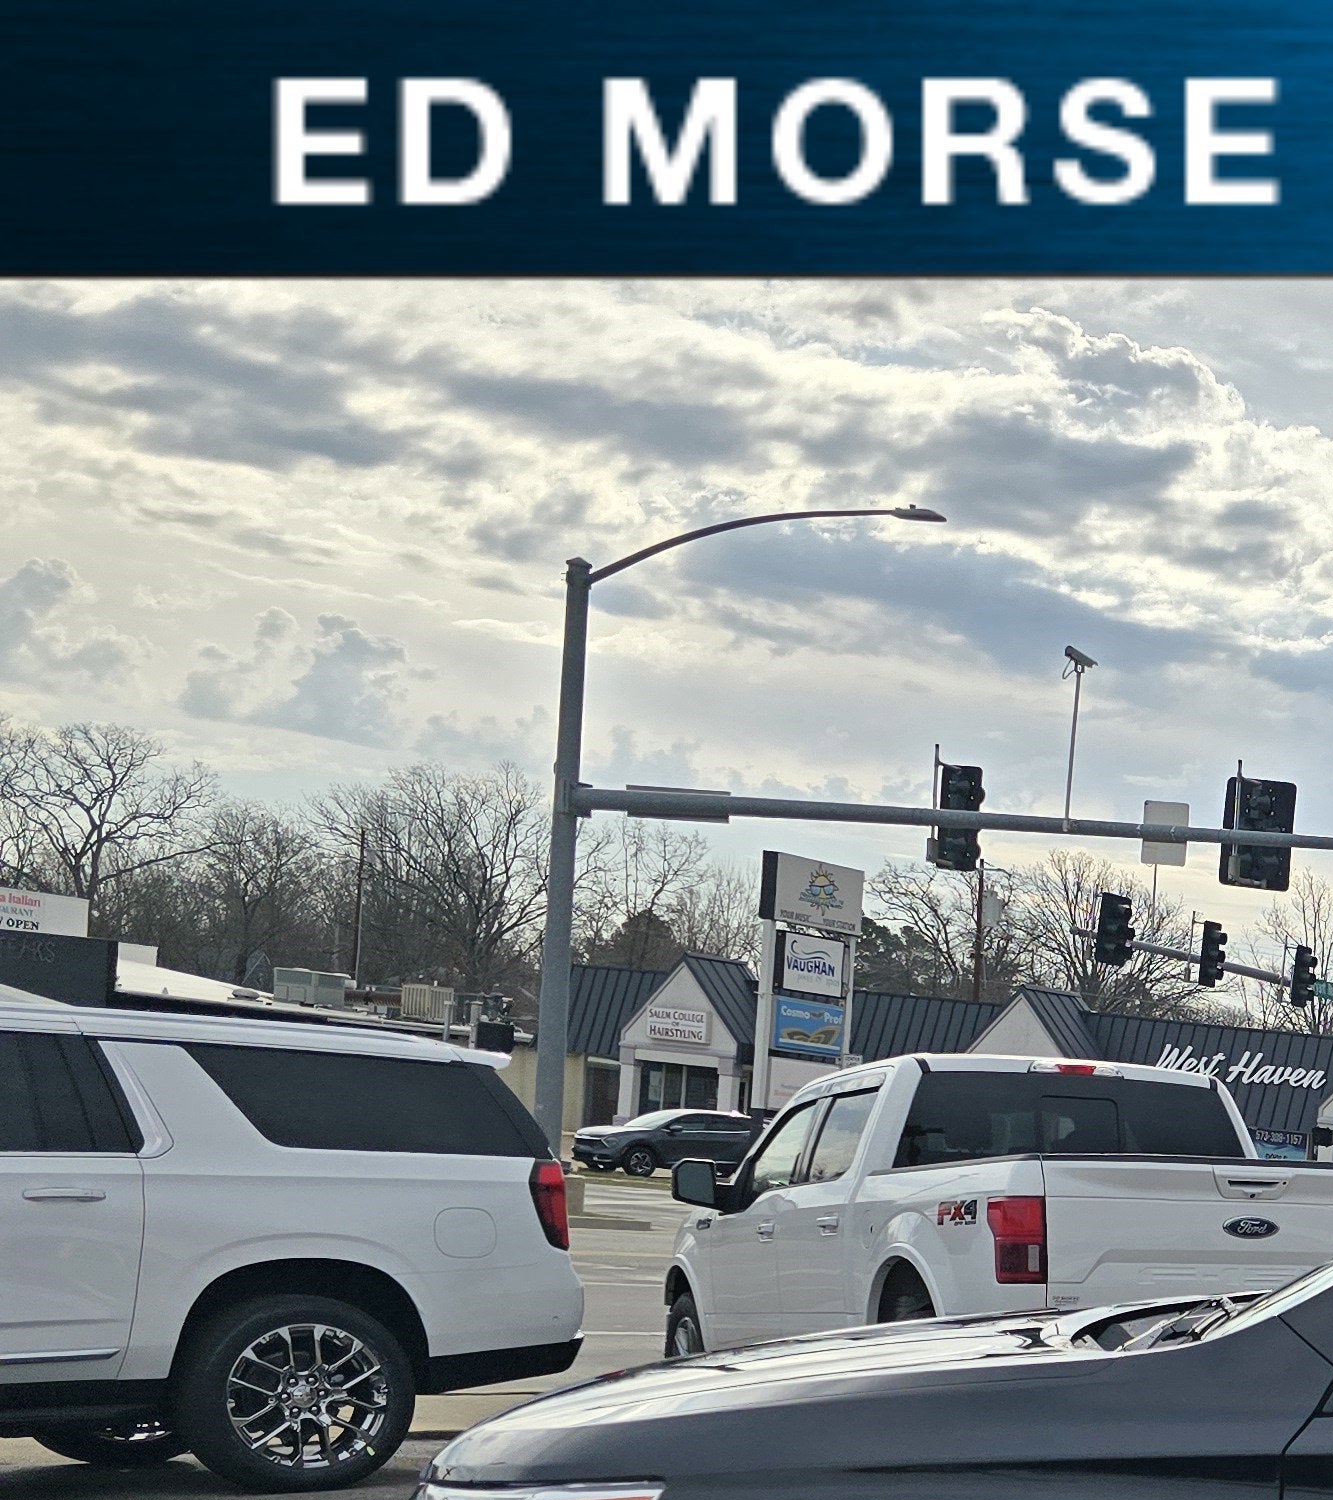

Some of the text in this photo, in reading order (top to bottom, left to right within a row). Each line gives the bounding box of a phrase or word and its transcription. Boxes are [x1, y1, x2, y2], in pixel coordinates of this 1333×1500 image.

[6, 917, 40, 931] OPEN
[786, 955, 836, 978] VAUGHAN
[648, 1008, 704, 1024] SALEM COLLEGE
[781, 1005, 844, 1025] Cosmo Prof
[649, 1024, 703, 1041] HAIRSTYLING
[1155, 1043, 1328, 1090] West Haven
[937, 1199, 978, 1226] FX4
[1237, 1218, 1268, 1234] Ford
